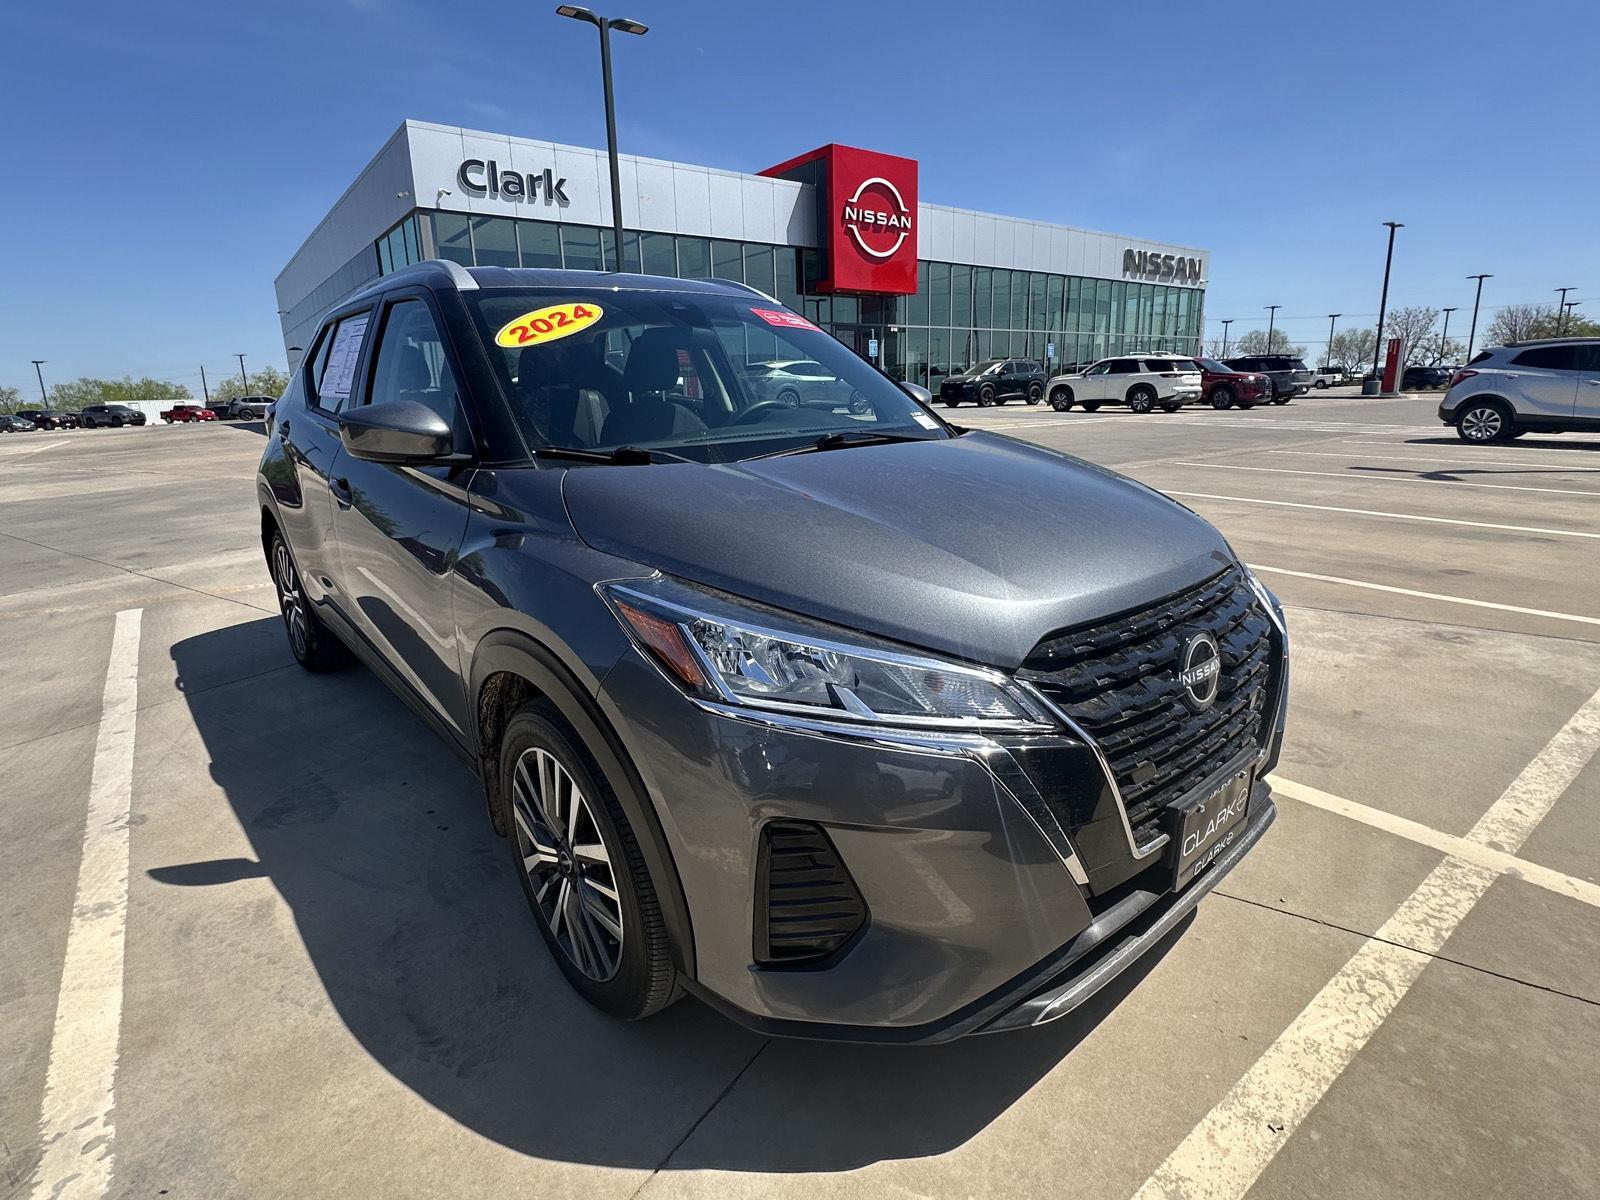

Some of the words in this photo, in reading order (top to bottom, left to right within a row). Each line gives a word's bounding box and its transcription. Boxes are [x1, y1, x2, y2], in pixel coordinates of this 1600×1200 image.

[457, 159, 571, 208] Clark
[845, 207, 912, 228] NISSAN
[1123, 249, 1202, 283] NISSAN
[509, 304, 593, 344] 2024
[1182, 657, 1221, 686] NISSAN
[1183, 800, 1237, 858] CLARK
[1193, 838, 1227, 875] CLARK
